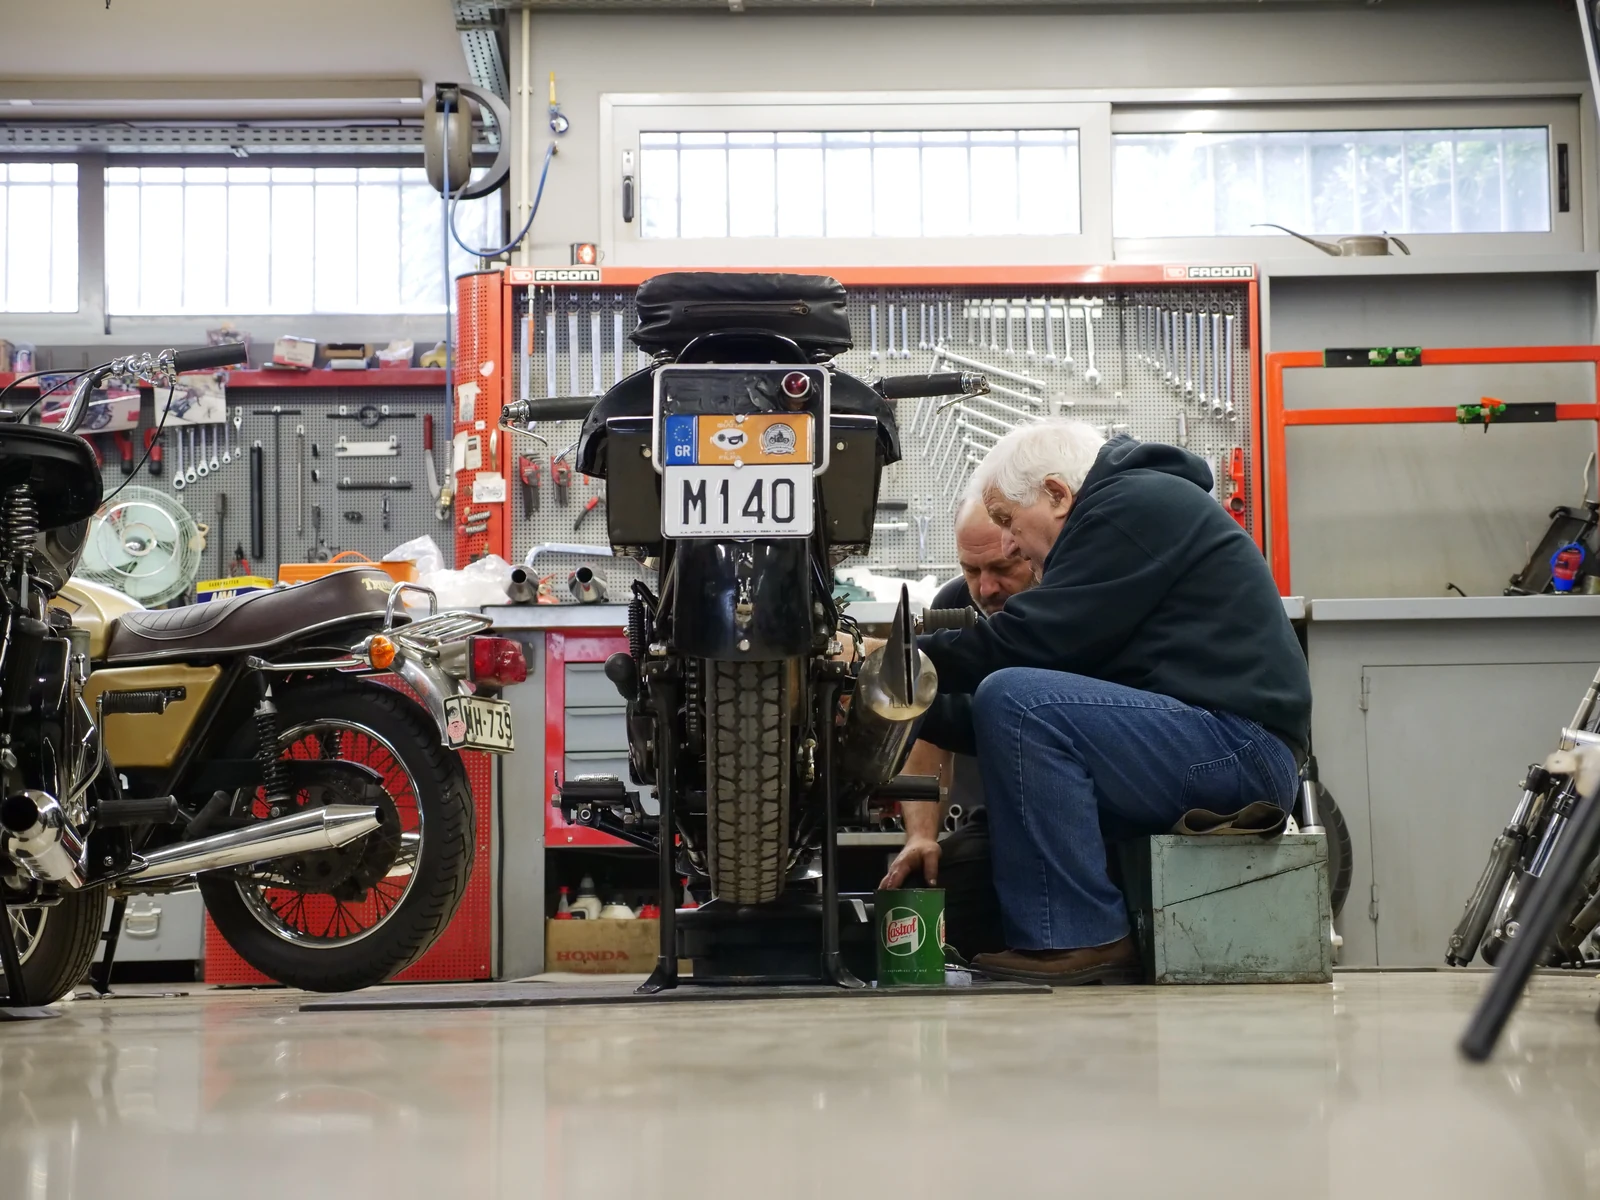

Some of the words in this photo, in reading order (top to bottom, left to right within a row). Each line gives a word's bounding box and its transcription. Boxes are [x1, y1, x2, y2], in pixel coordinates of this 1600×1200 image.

[535, 270, 599, 281] FACOM
[1189, 266, 1252, 278] FACOM
[674, 445, 691, 457] GR
[682, 478, 796, 525] M140
[888, 917, 917, 944] Castrol
[556, 951, 630, 961] HONDA
